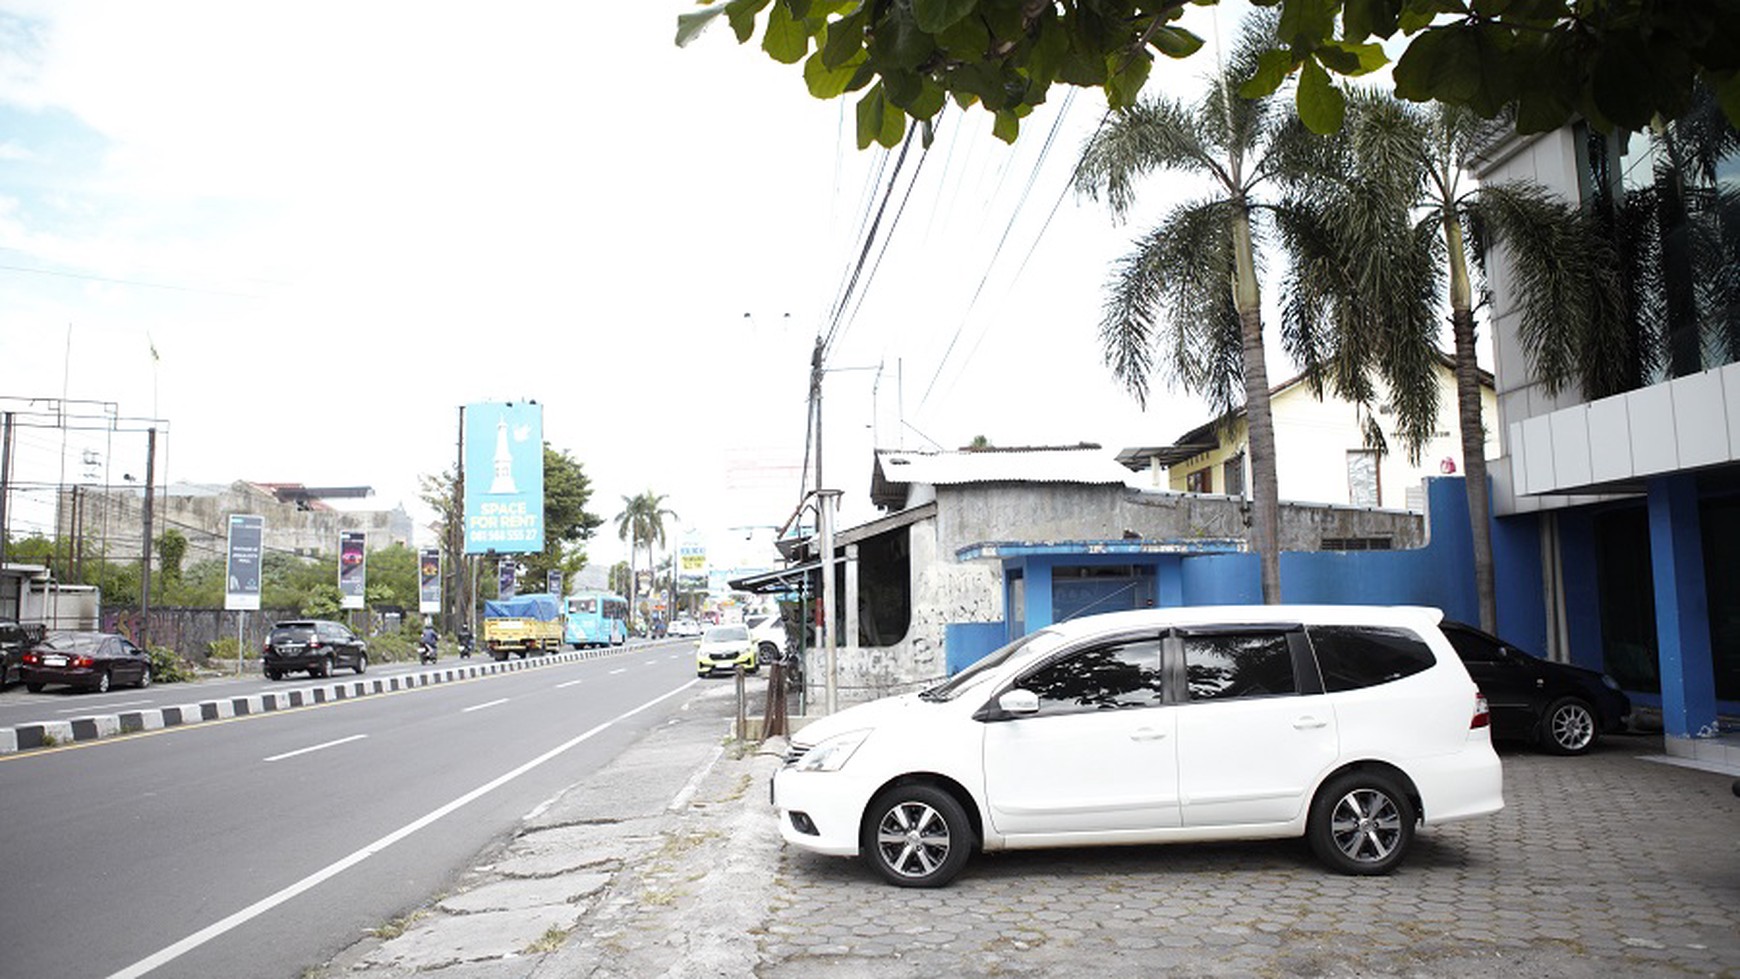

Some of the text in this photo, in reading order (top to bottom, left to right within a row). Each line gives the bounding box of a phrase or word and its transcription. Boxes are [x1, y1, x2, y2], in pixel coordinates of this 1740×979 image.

[480, 502, 526, 515] SPACE
[470, 514, 538, 529] FOR RENT
